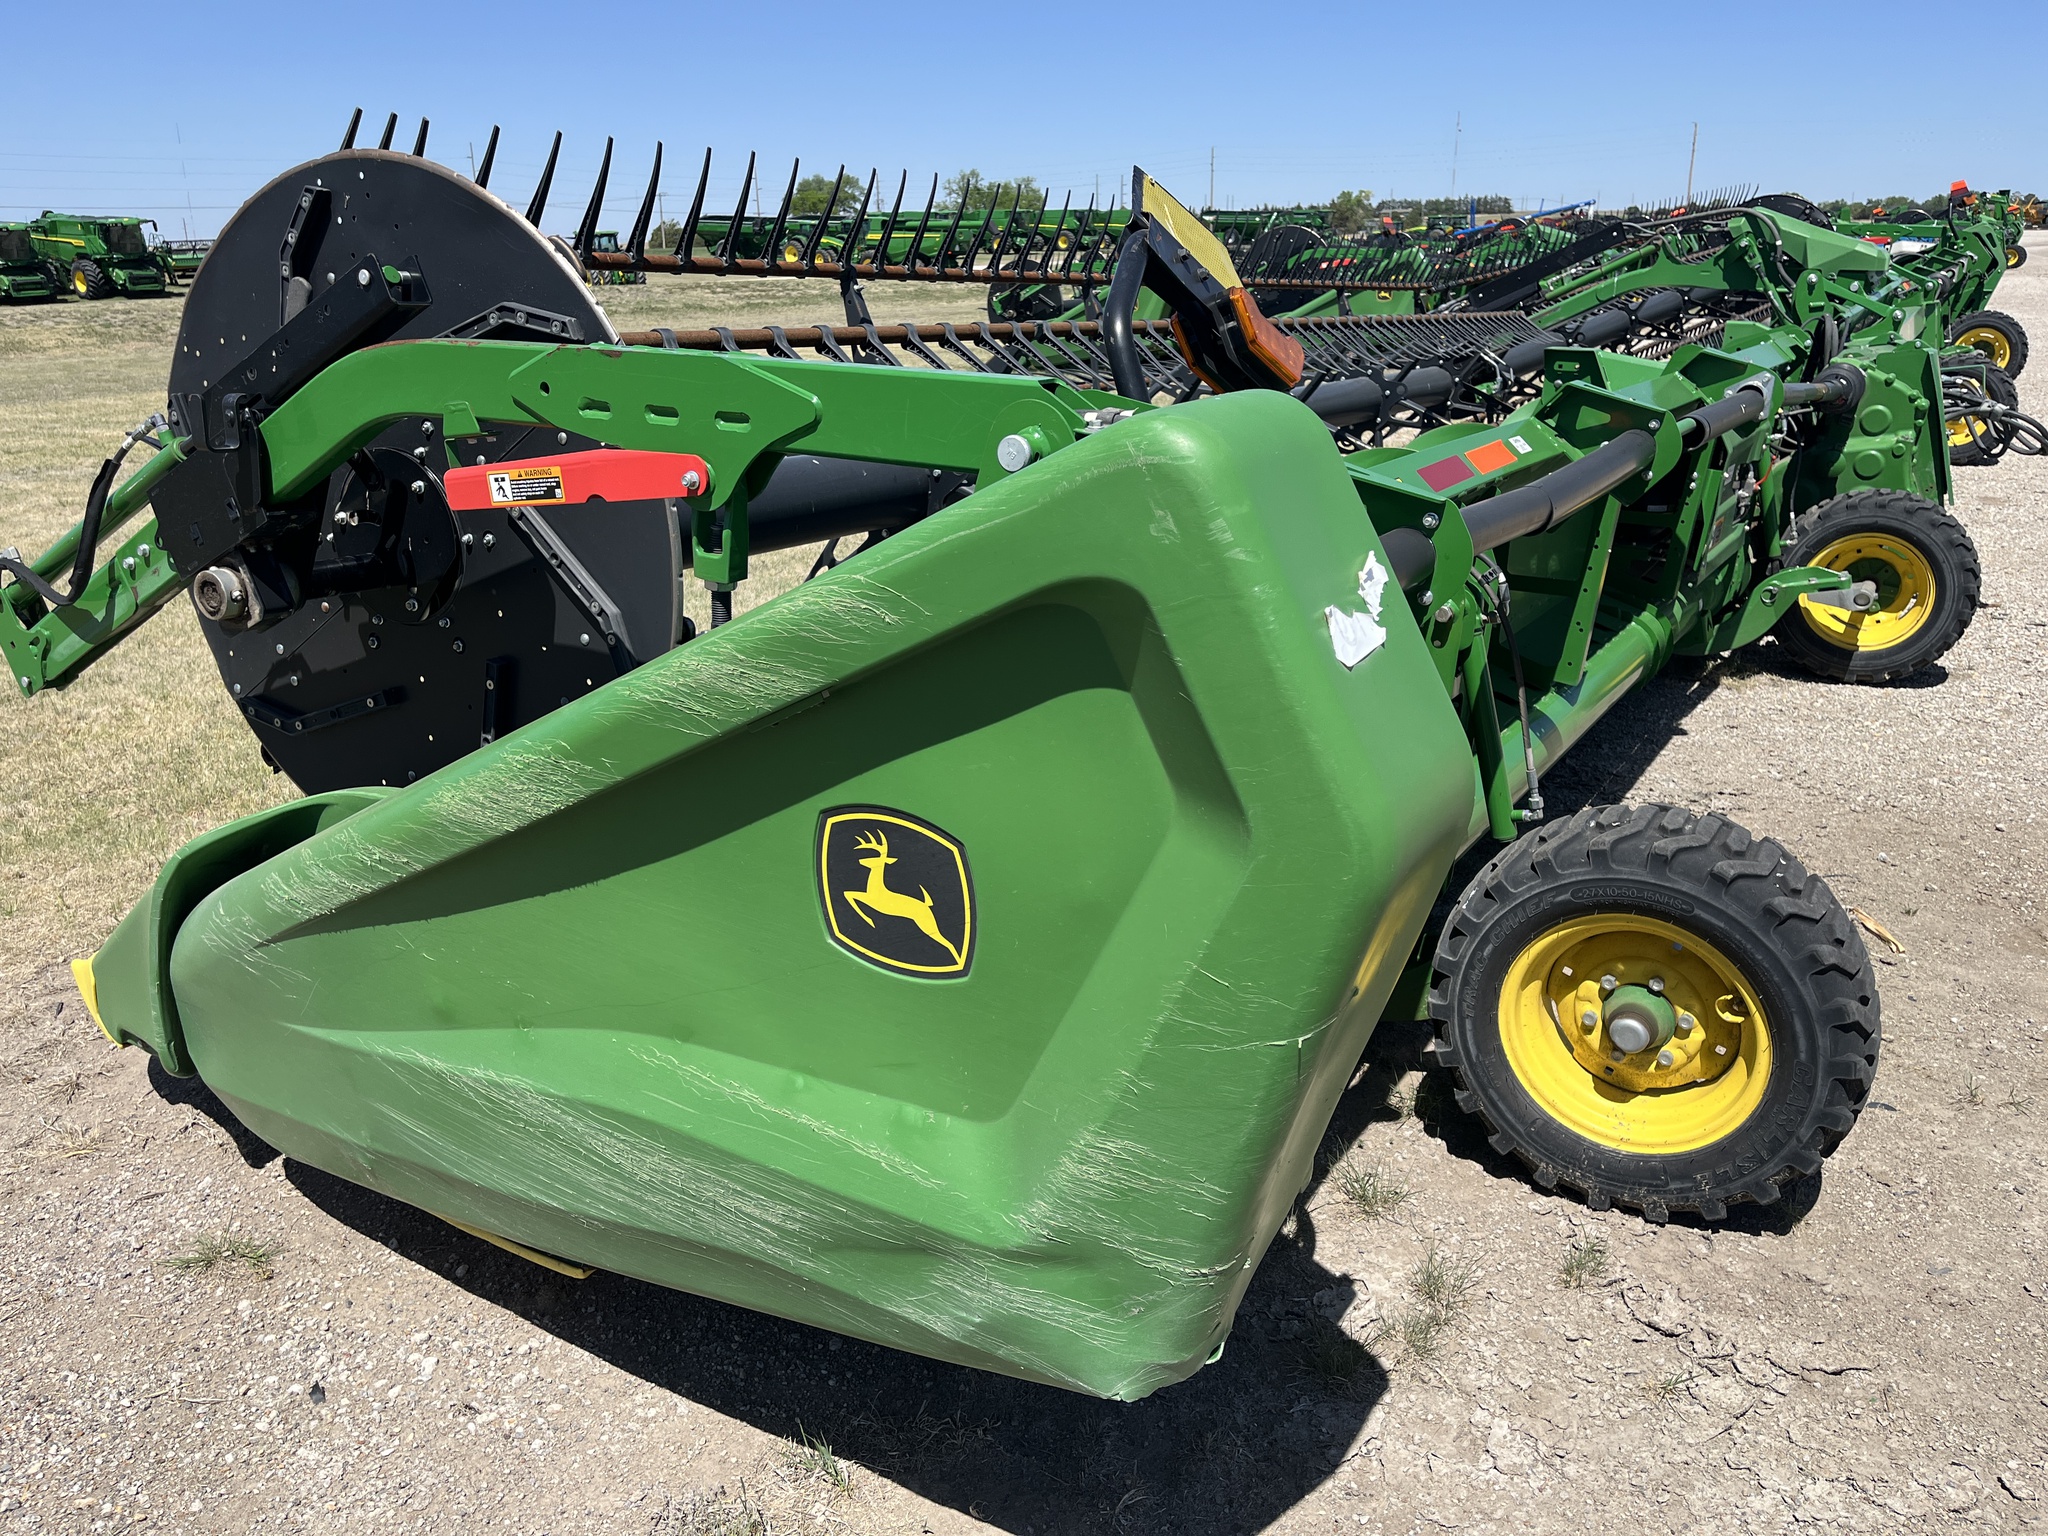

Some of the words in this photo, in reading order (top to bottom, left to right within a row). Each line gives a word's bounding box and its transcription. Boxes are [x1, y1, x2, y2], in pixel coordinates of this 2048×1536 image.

[524, 468, 552, 477] WARNING
[1462, 951, 1489, 1018] TRAC
[1490, 891, 1556, 947] CHIEF
[1693, 1059, 1814, 1190] CARLISLE
